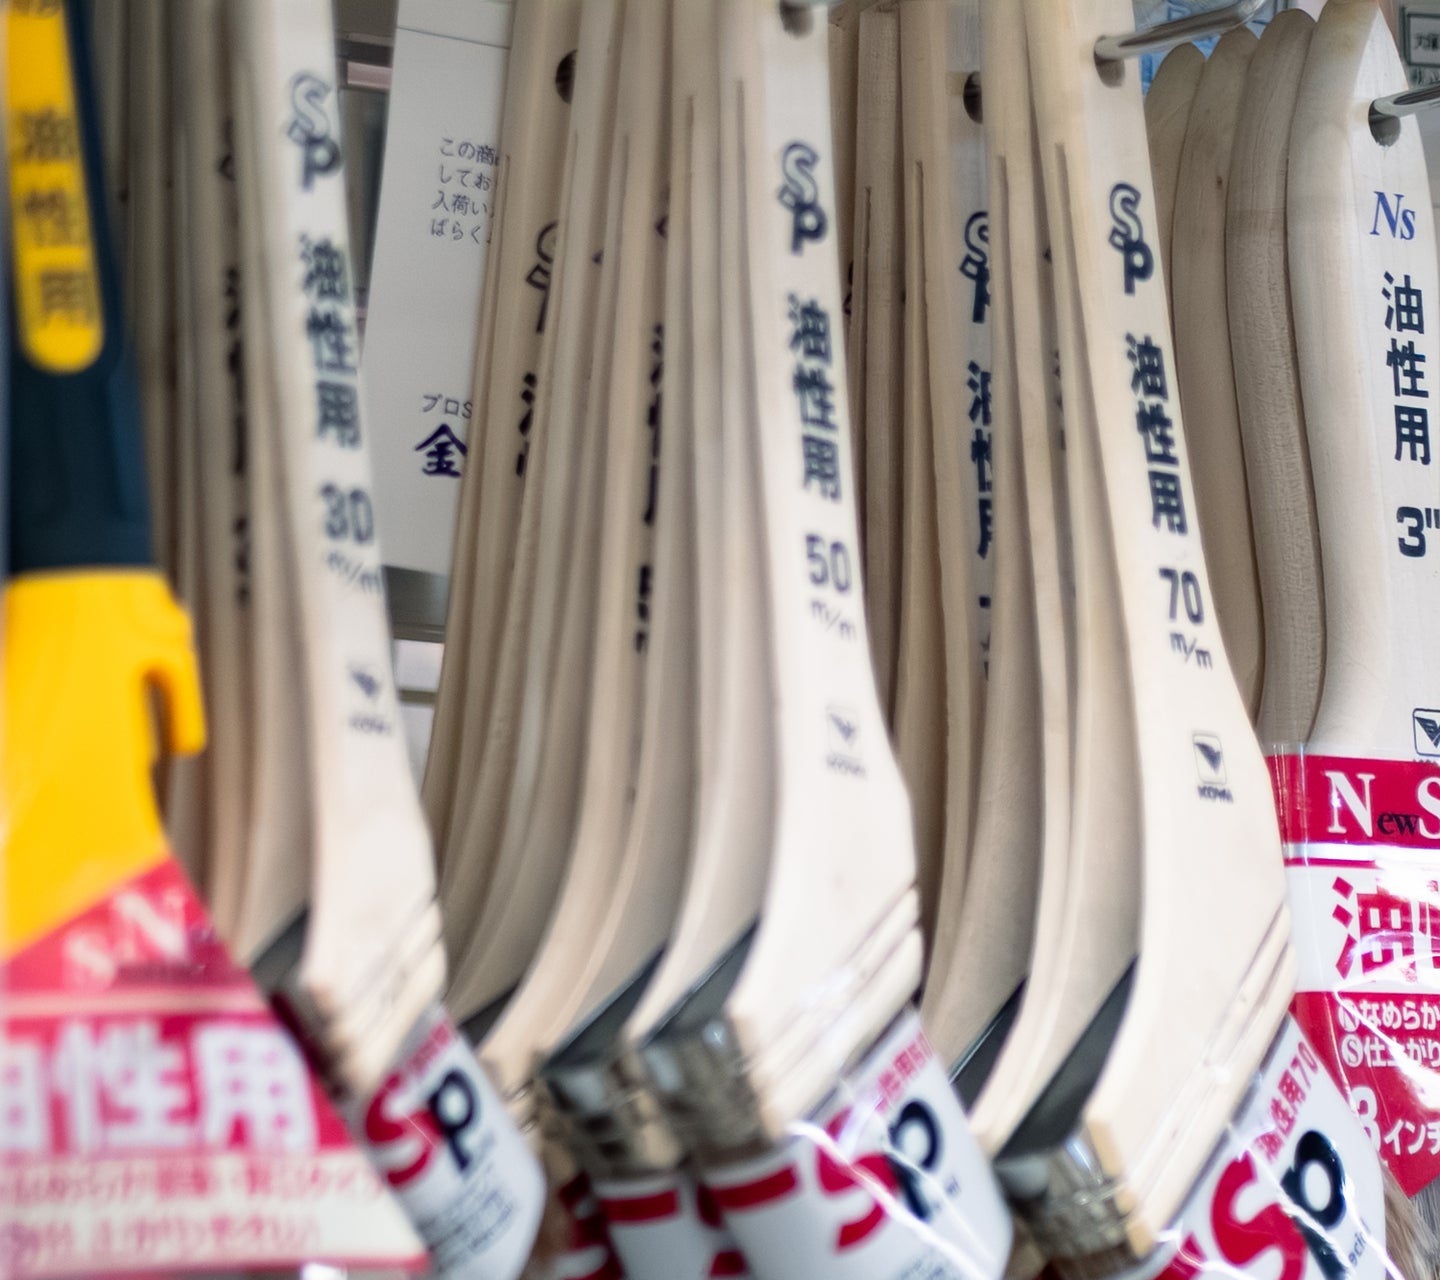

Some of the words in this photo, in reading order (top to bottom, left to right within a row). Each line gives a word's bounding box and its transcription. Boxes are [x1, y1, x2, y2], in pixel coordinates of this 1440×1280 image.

[440, 137, 500, 167] この商
[430, 218, 492, 245] ばらく
[432, 189, 495, 219] 入荷い
[1370, 190, 1417, 243] Ns
[786, 295, 844, 503] 油性用
[1381, 273, 1432, 467] 油性用
[1126, 334, 1188, 536] 油性用
[319, 485, 375, 547] 30
[805, 534, 853, 595] 50
[1159, 568, 1205, 627] 70
